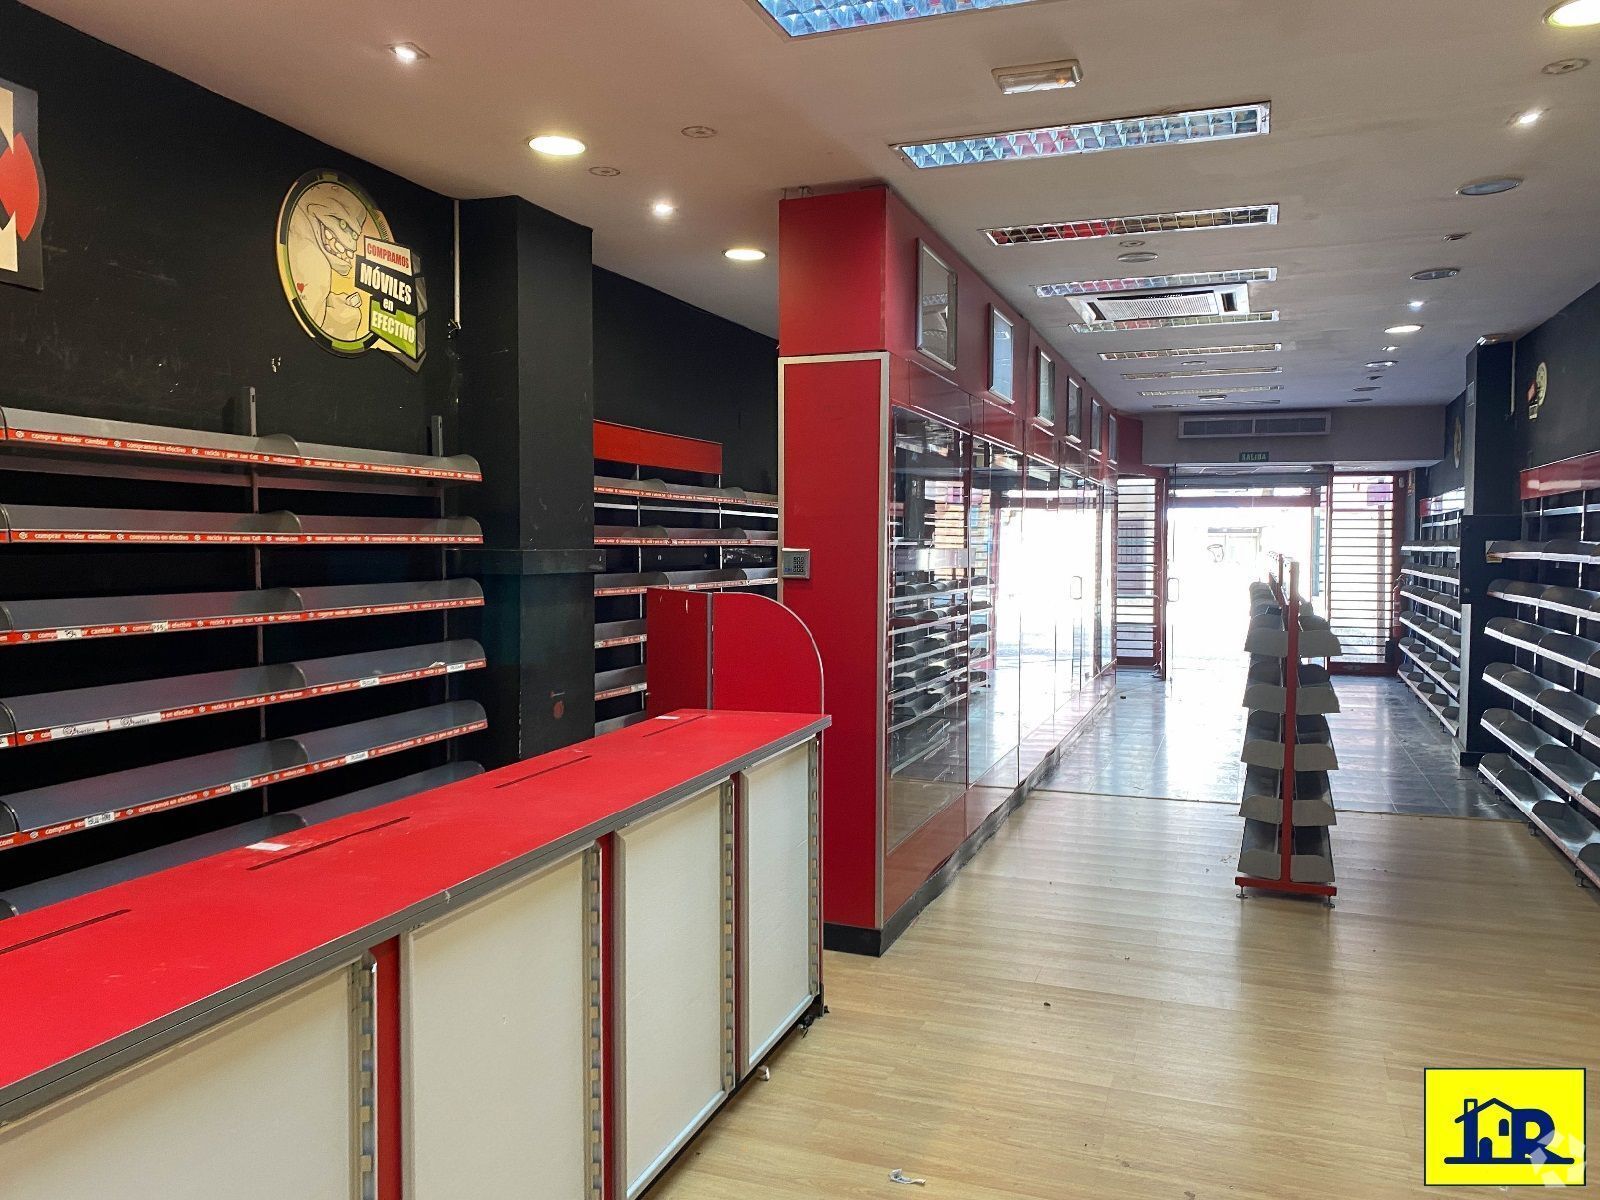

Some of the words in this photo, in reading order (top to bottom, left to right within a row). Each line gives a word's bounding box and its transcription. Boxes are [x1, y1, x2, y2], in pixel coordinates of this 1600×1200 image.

[366, 243, 409, 269] COMPRAMOS
[360, 263, 412, 305] MÓVILES
[382, 298, 394, 312] en
[371, 312, 415, 344] EFECTIVO
[32, 433, 58, 443] comprar
[1241, 453, 1267, 461] SALIDA
[34, 533, 61, 541] comprar
[139, 802, 169, 813] compramos
[45, 823, 71, 835] comprar
